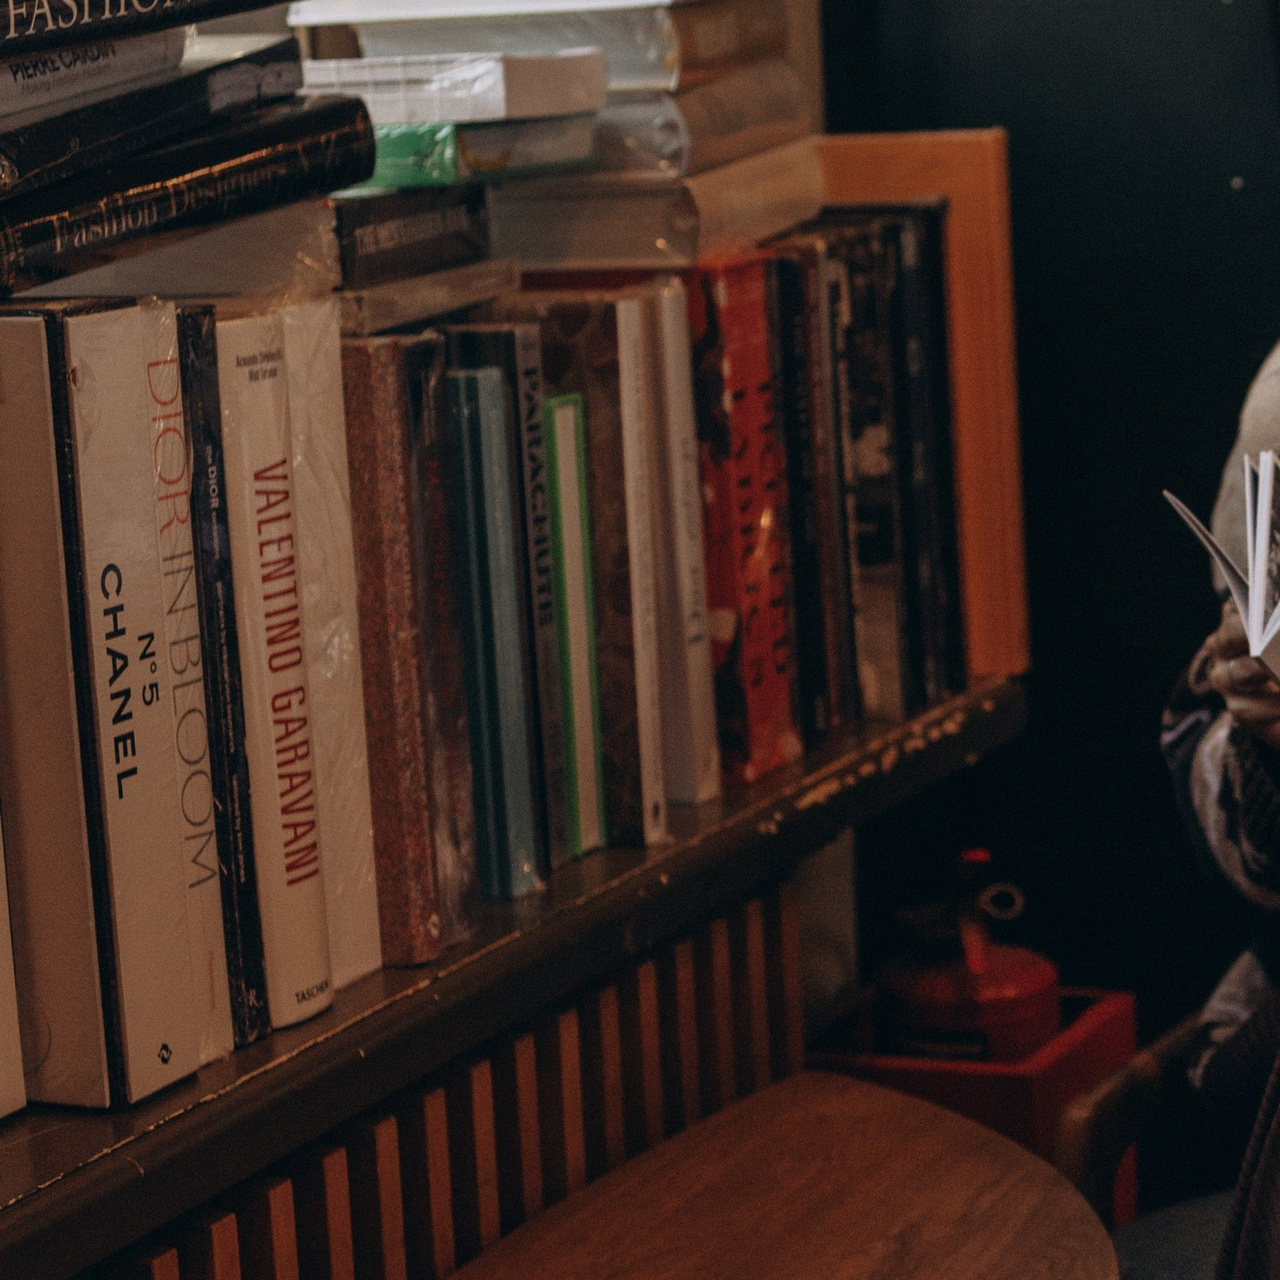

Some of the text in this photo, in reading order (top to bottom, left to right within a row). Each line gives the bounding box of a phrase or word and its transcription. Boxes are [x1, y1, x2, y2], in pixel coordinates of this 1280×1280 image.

[147, 358, 218, 889] DIOR IN BLOOM
[207, 465, 220, 510] DIOR
[100, 563, 138, 799] CHANEL
[253, 458, 320, 887] VALENTINO GARAVANI
